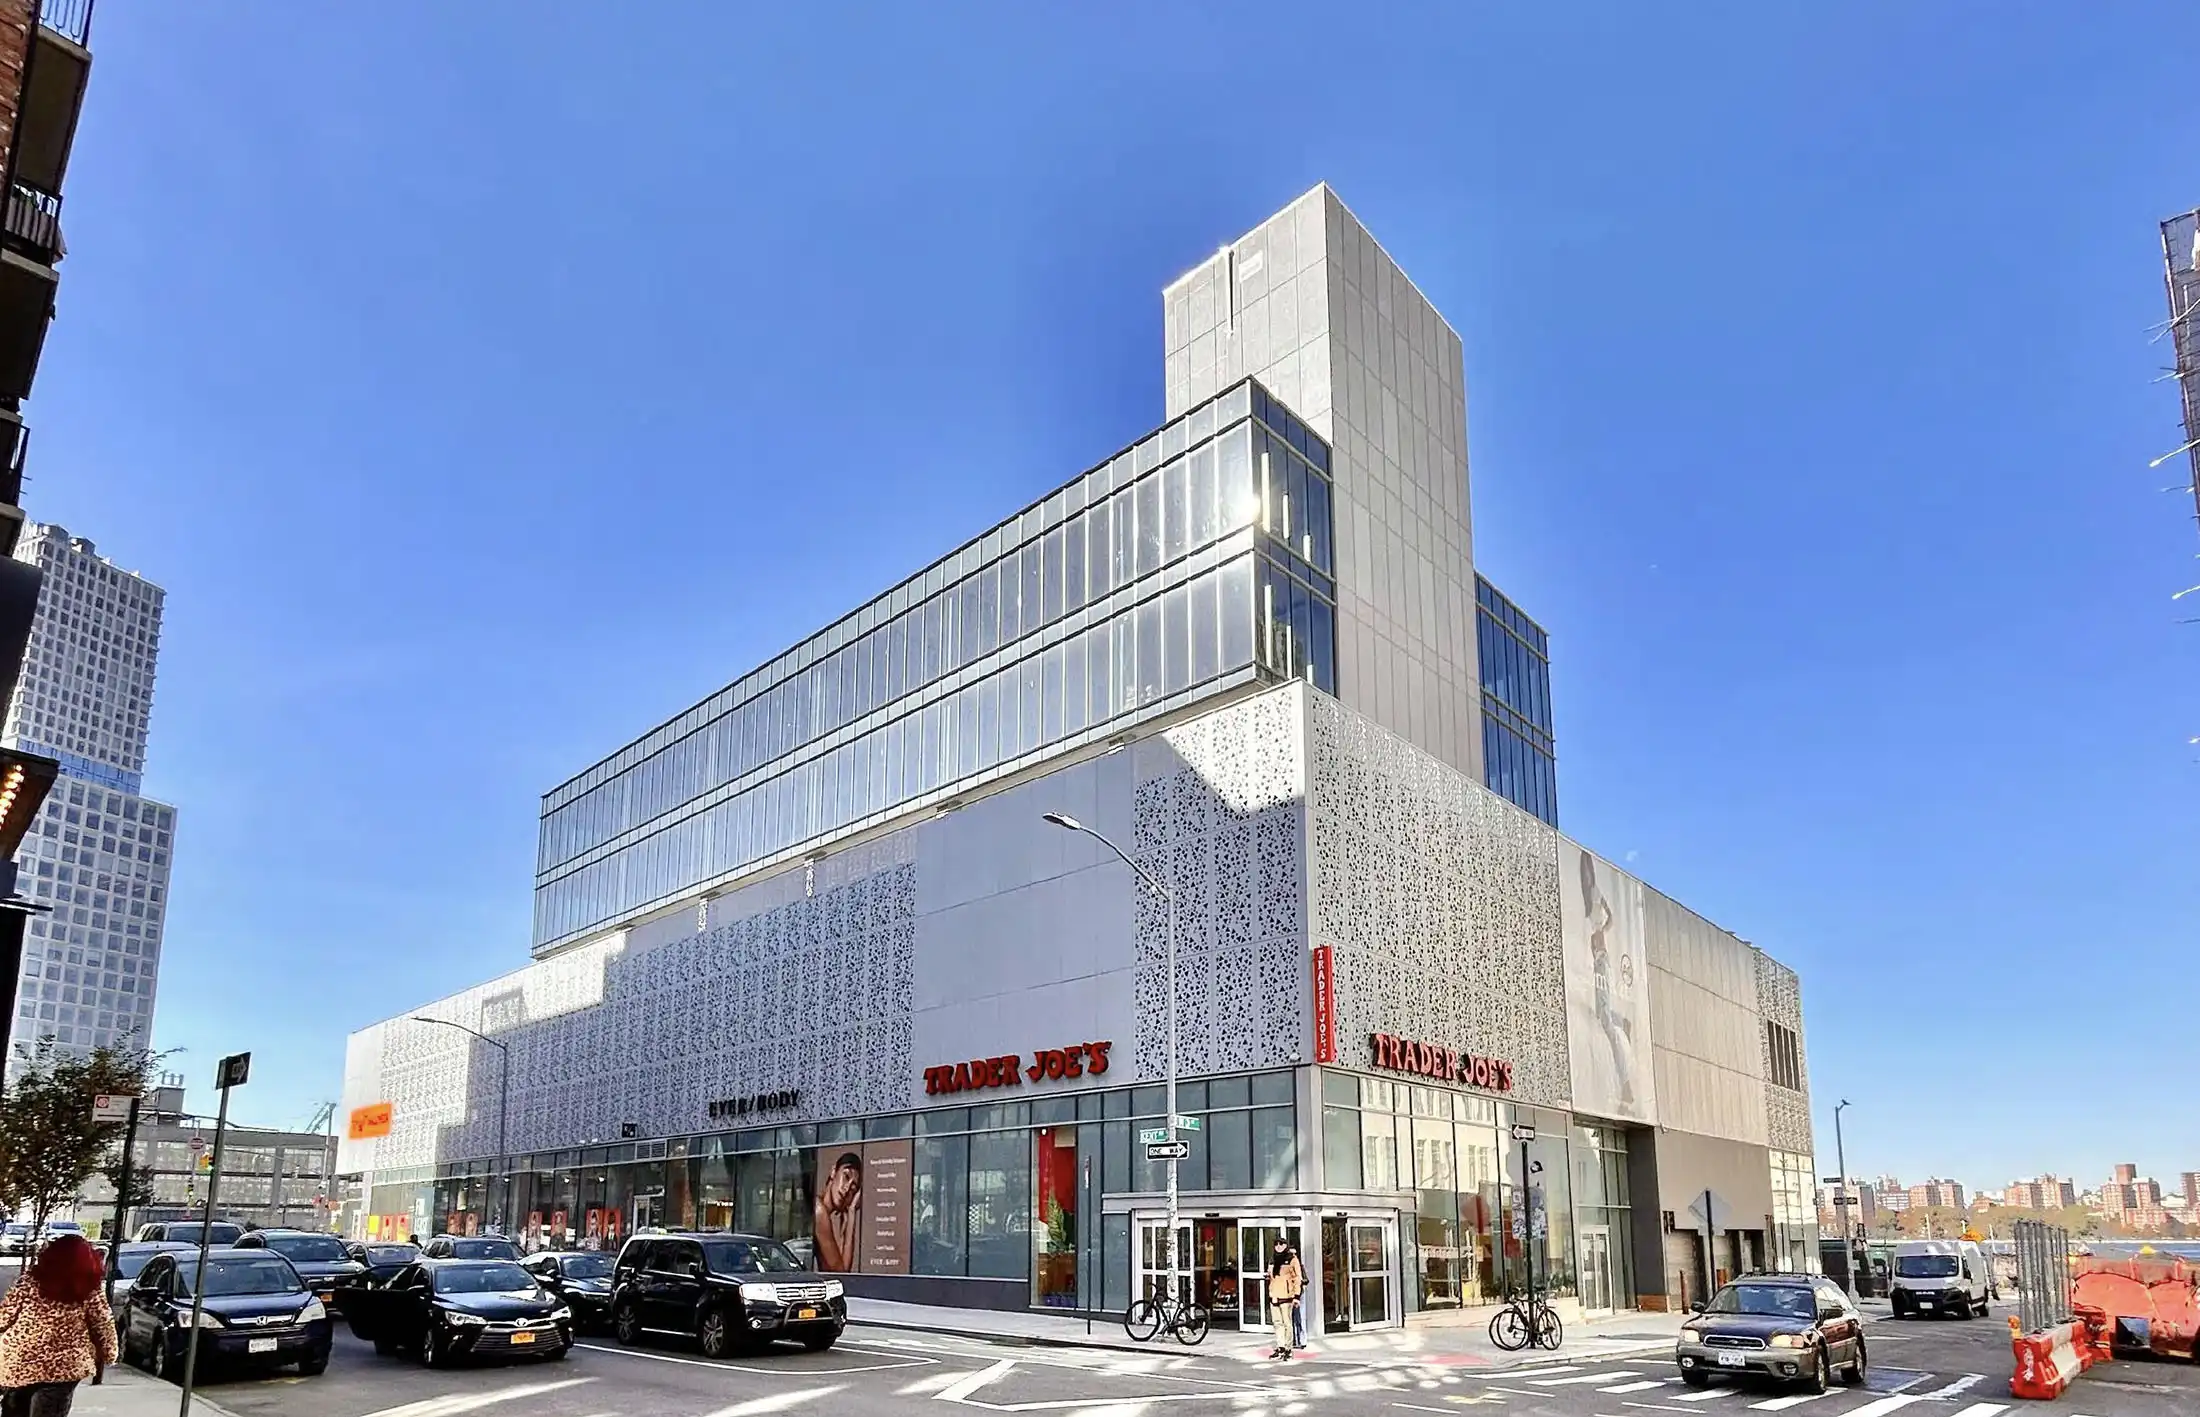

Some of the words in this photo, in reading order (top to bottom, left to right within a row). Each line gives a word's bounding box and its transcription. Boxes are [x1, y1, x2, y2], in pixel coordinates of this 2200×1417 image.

[1316, 949, 1326, 1011] TRADER
[924, 1054, 1022, 1095] TRADER
[1026, 1041, 1112, 1083] JOE'S
[1371, 1033, 1458, 1081] TRADER
[1460, 1053, 1514, 1091] JOE'S
[1150, 1147, 1162, 1155] ONE
[1169, 1147, 1183, 1155] WAY
